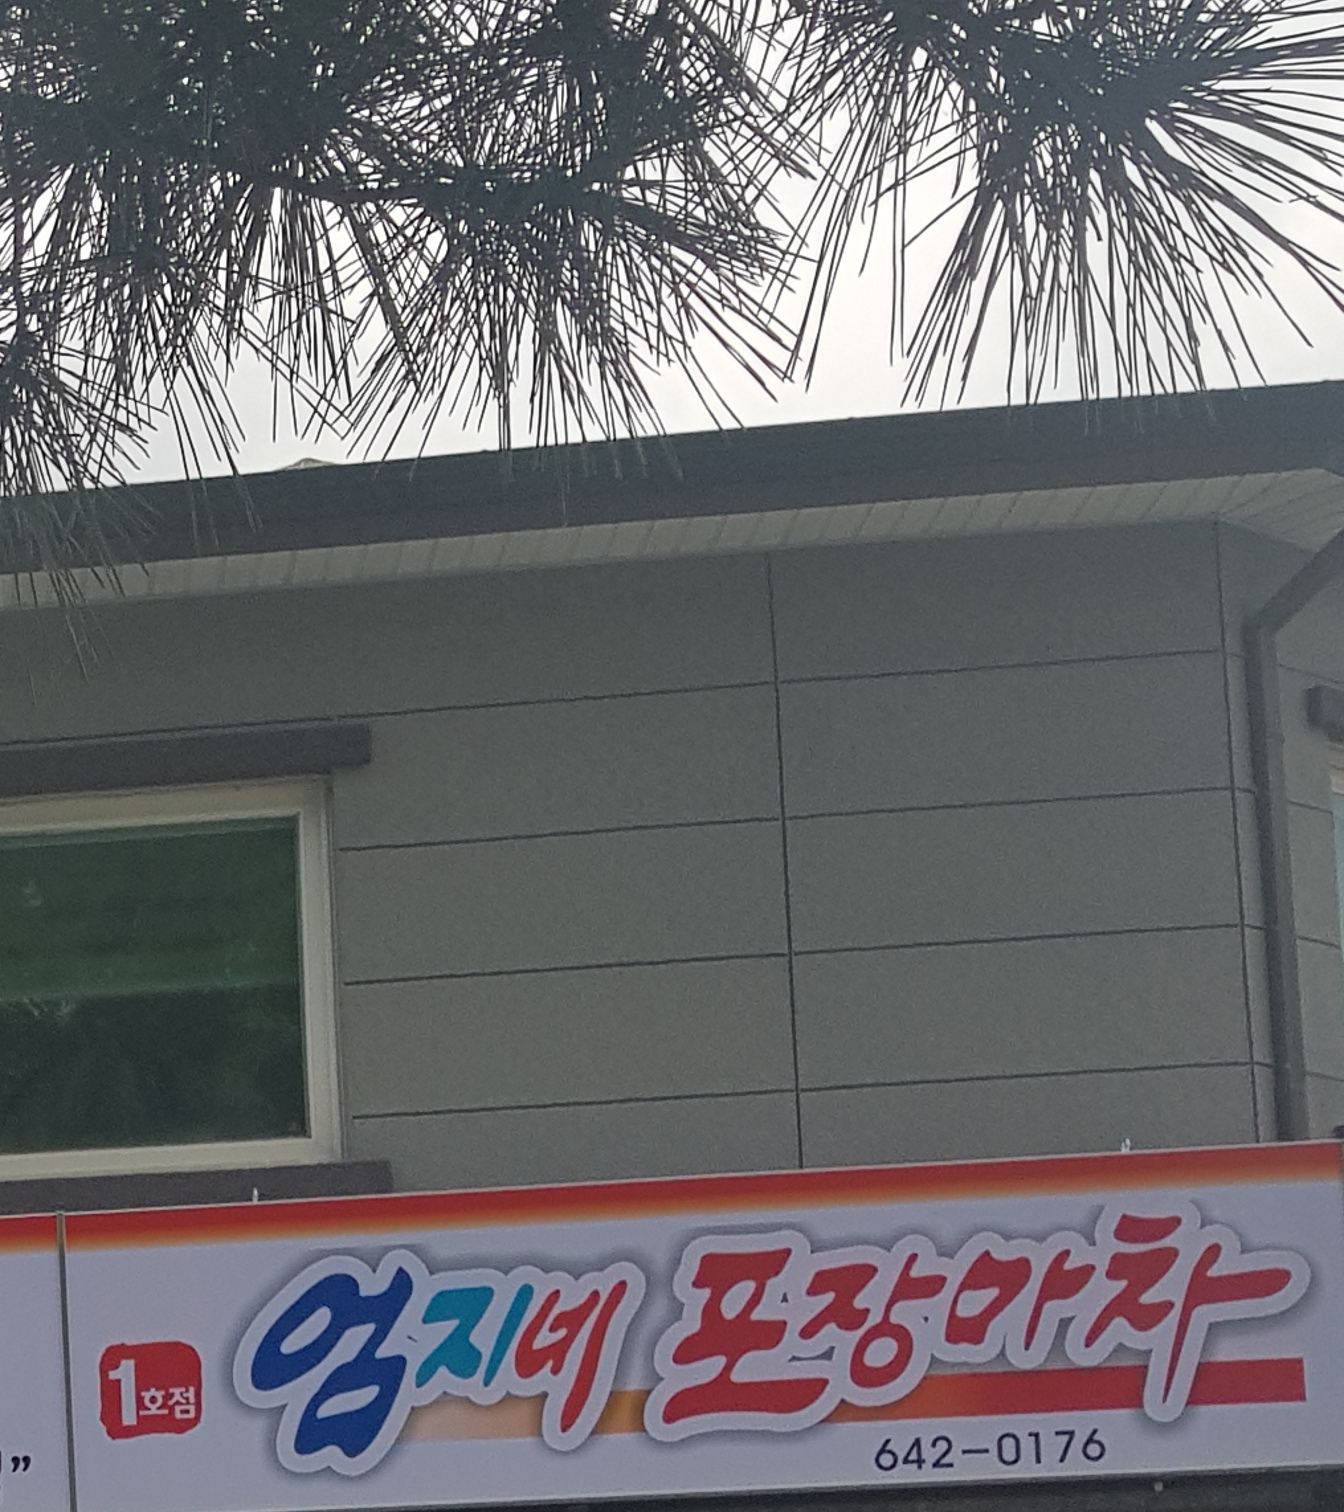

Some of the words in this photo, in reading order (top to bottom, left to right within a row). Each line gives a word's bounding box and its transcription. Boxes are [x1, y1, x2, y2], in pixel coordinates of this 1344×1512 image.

[249, 1266, 628, 1458] 엄지네
[662, 1214, 1292, 1426] 포장마차
[109, 1357, 197, 1428] 1호점
[874, 1425, 1107, 1473] 642-0176
